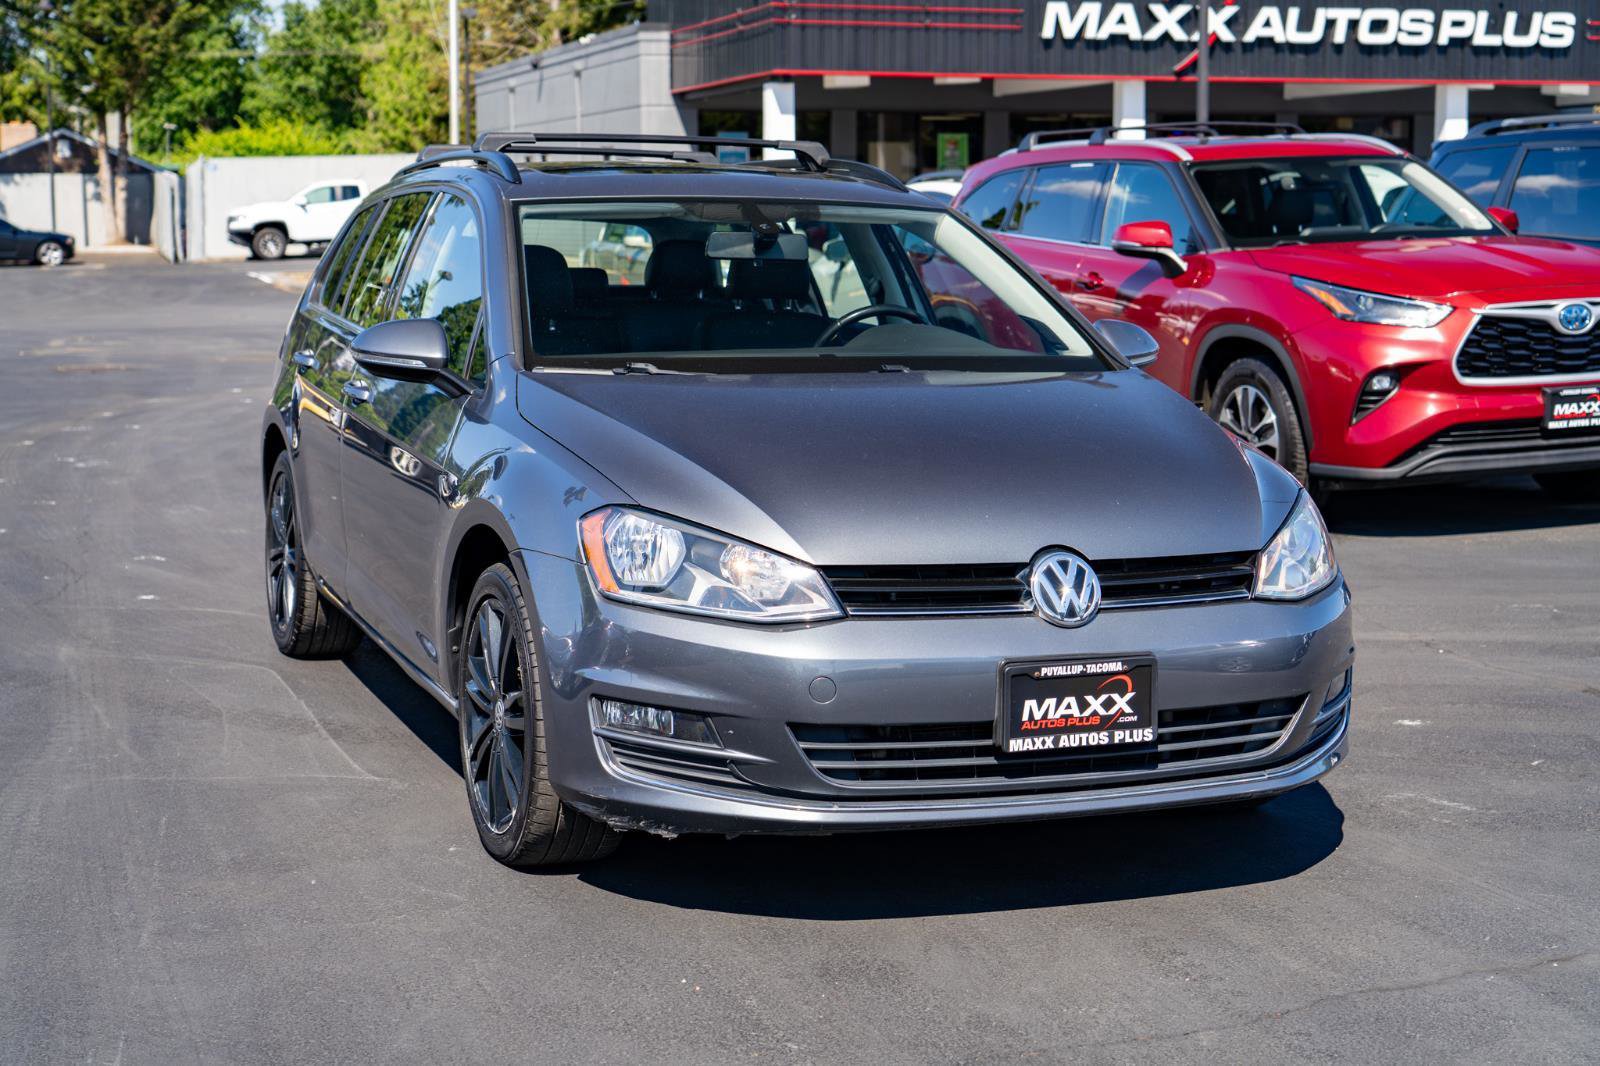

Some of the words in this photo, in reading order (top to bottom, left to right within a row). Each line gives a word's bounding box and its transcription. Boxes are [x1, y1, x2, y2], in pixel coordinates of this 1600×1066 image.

[1041, 1, 1240, 43] MAXX
[1242, 6, 1435, 46] AUTOS
[1437, 10, 1576, 48] PLUS
[1553, 401, 1600, 416] MAXX
[1021, 692, 1136, 721] MAXX
[1021, 717, 1066, 731] AUTOS
[1067, 715, 1101, 727] PLUS
[1117, 715, 1137, 723] .COM
[1009, 736, 1055, 752] MAXX
[1059, 731, 1110, 748] AUTOS
[1113, 727, 1153, 744] PLUS
